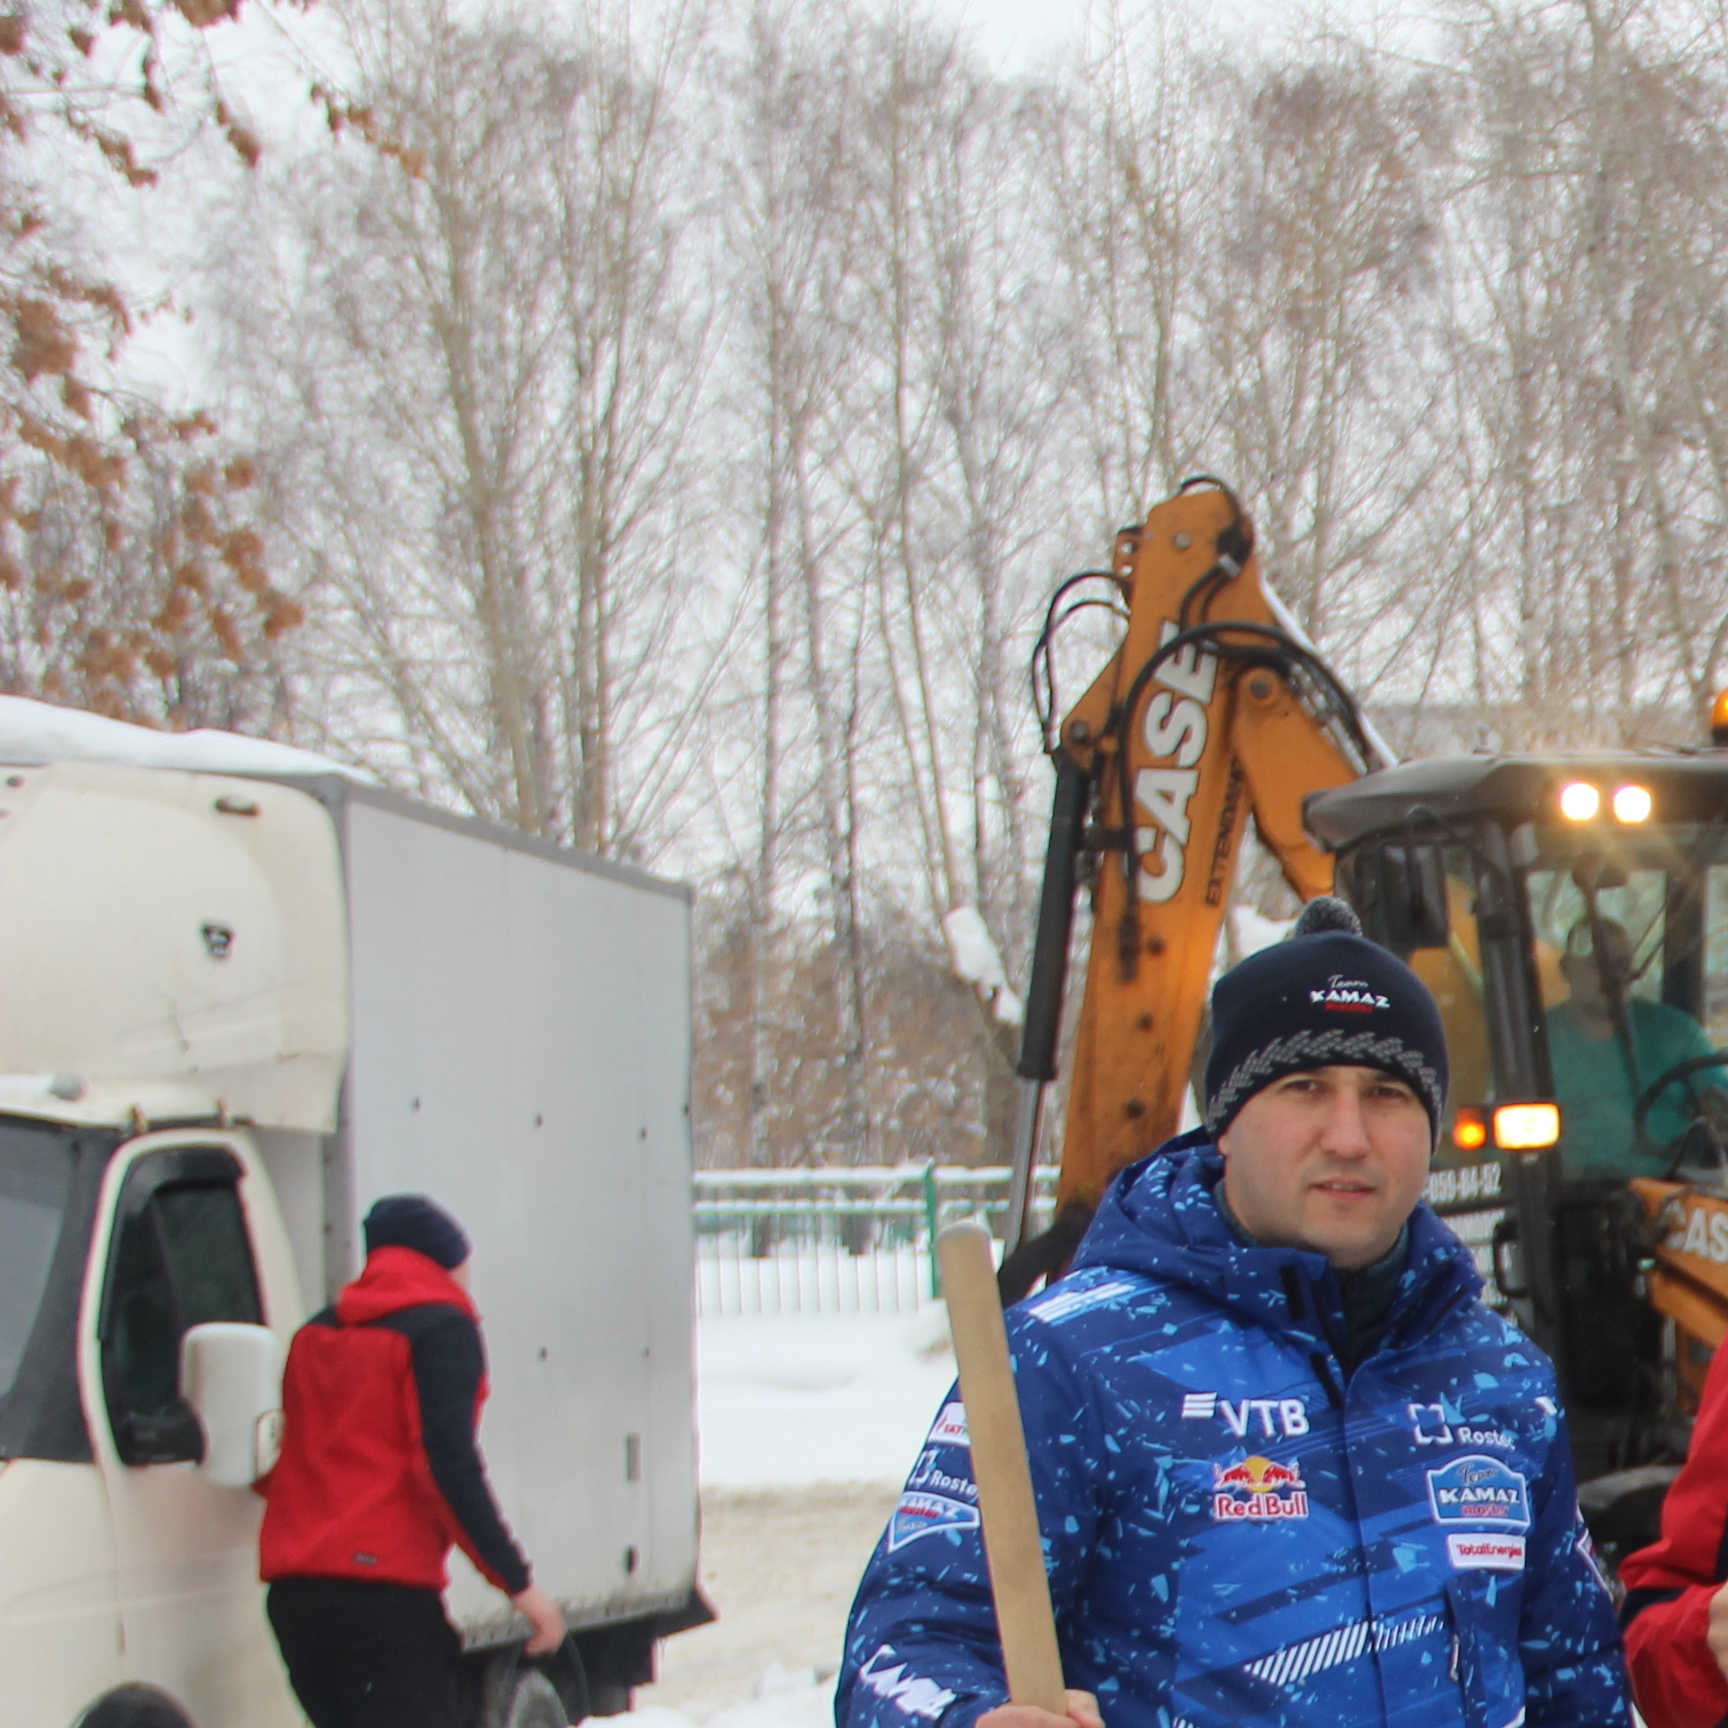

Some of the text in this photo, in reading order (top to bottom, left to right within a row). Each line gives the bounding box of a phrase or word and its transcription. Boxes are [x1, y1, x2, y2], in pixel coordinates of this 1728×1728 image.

[1132, 619, 1219, 902] CASE
[1310, 989, 1391, 1009] KAMAZ
[1219, 1398, 1310, 1437] VTB
[930, 1468, 980, 1500] Roste
[1439, 1486, 1521, 1504] KAMAZ
[1217, 1491, 1309, 1518] Red Bull
